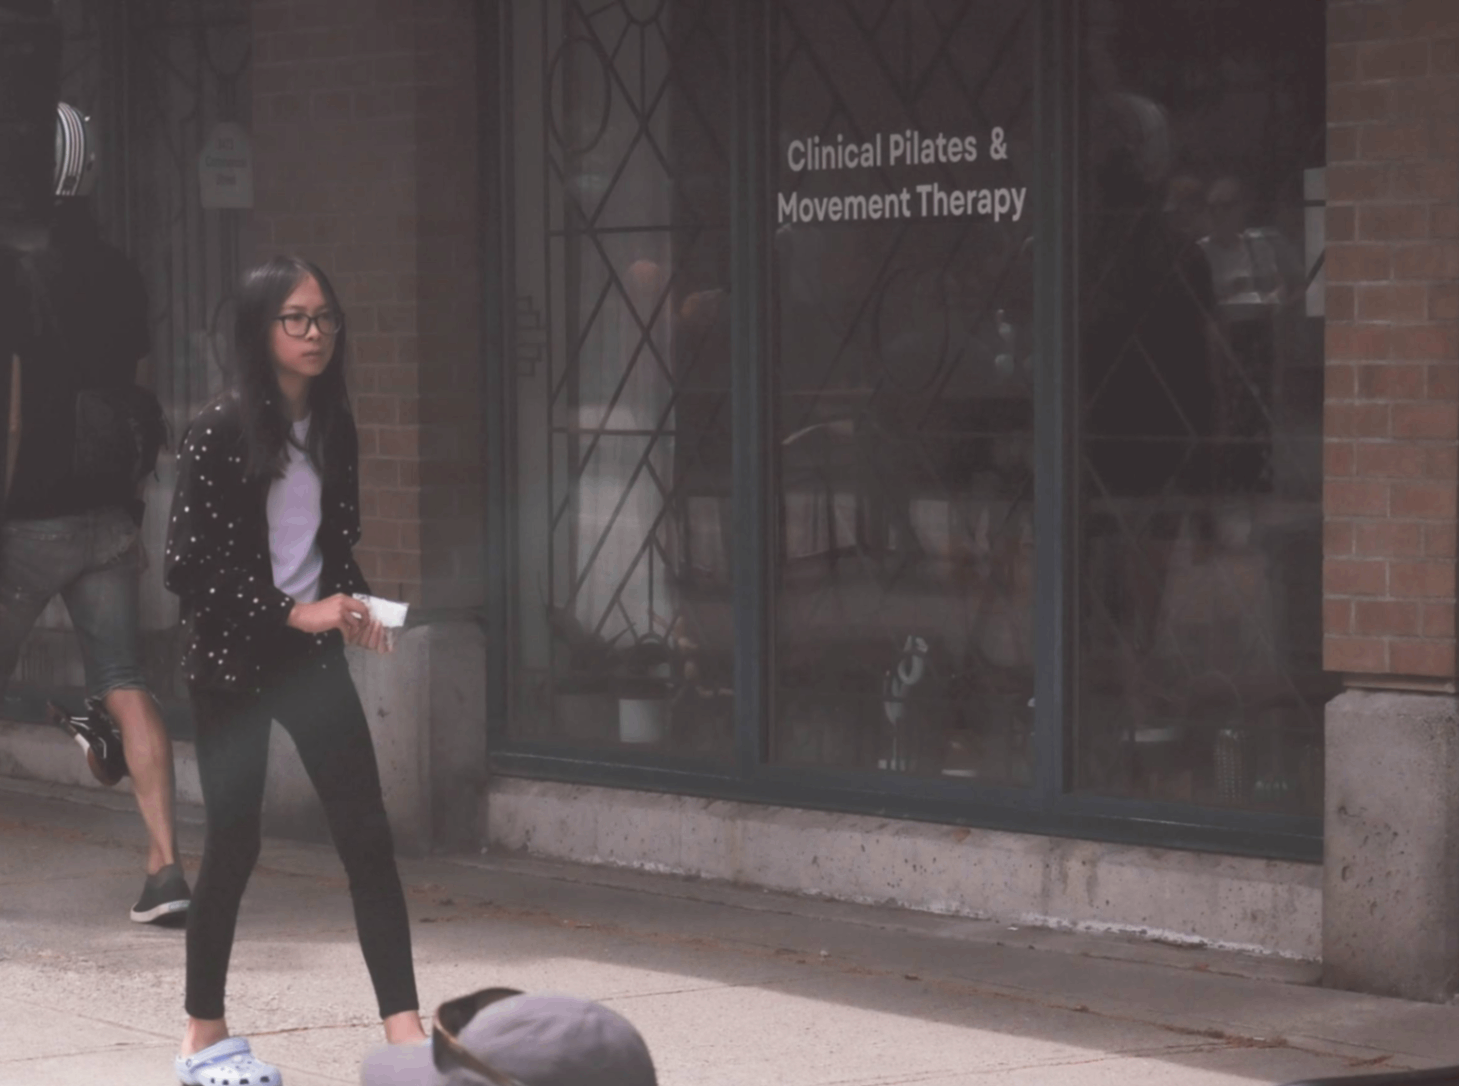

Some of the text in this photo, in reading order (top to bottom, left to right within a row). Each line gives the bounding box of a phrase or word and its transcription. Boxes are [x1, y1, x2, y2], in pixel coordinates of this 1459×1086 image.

[787, 126, 1008, 172] Clinical Pilates &
[777, 182, 1027, 224] Movement Therapy
